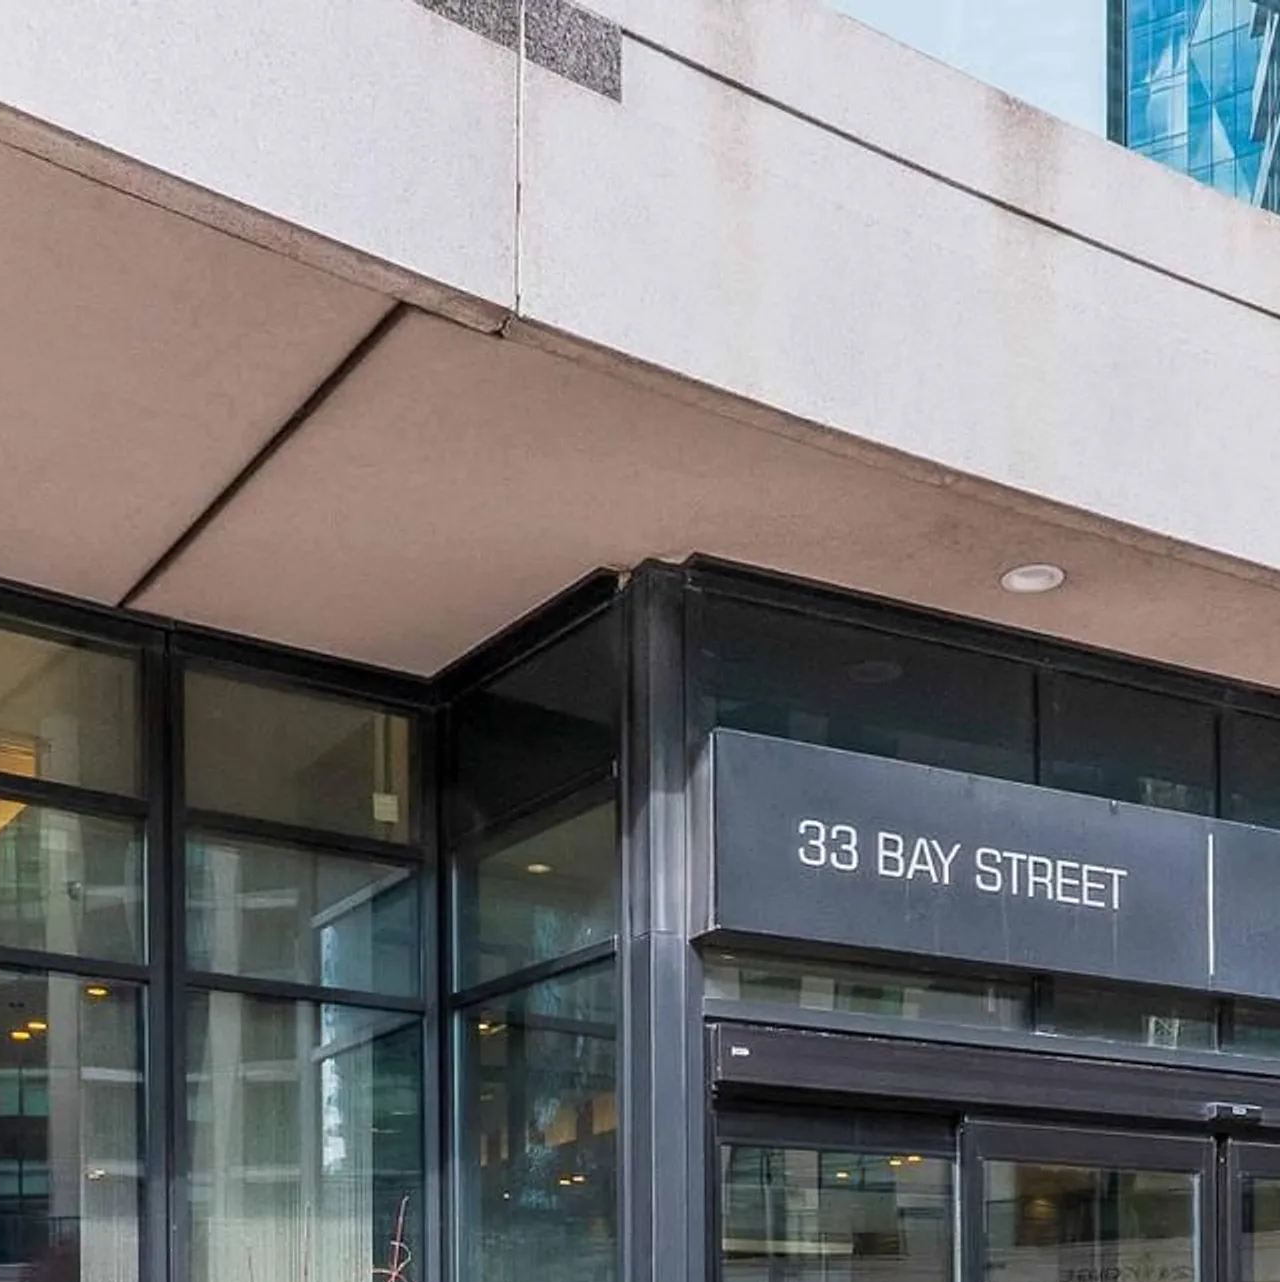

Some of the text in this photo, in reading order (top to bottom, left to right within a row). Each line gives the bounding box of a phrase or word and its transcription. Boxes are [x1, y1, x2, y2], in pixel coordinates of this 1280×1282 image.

[798, 819, 1128, 911] 33 BAY STREET
